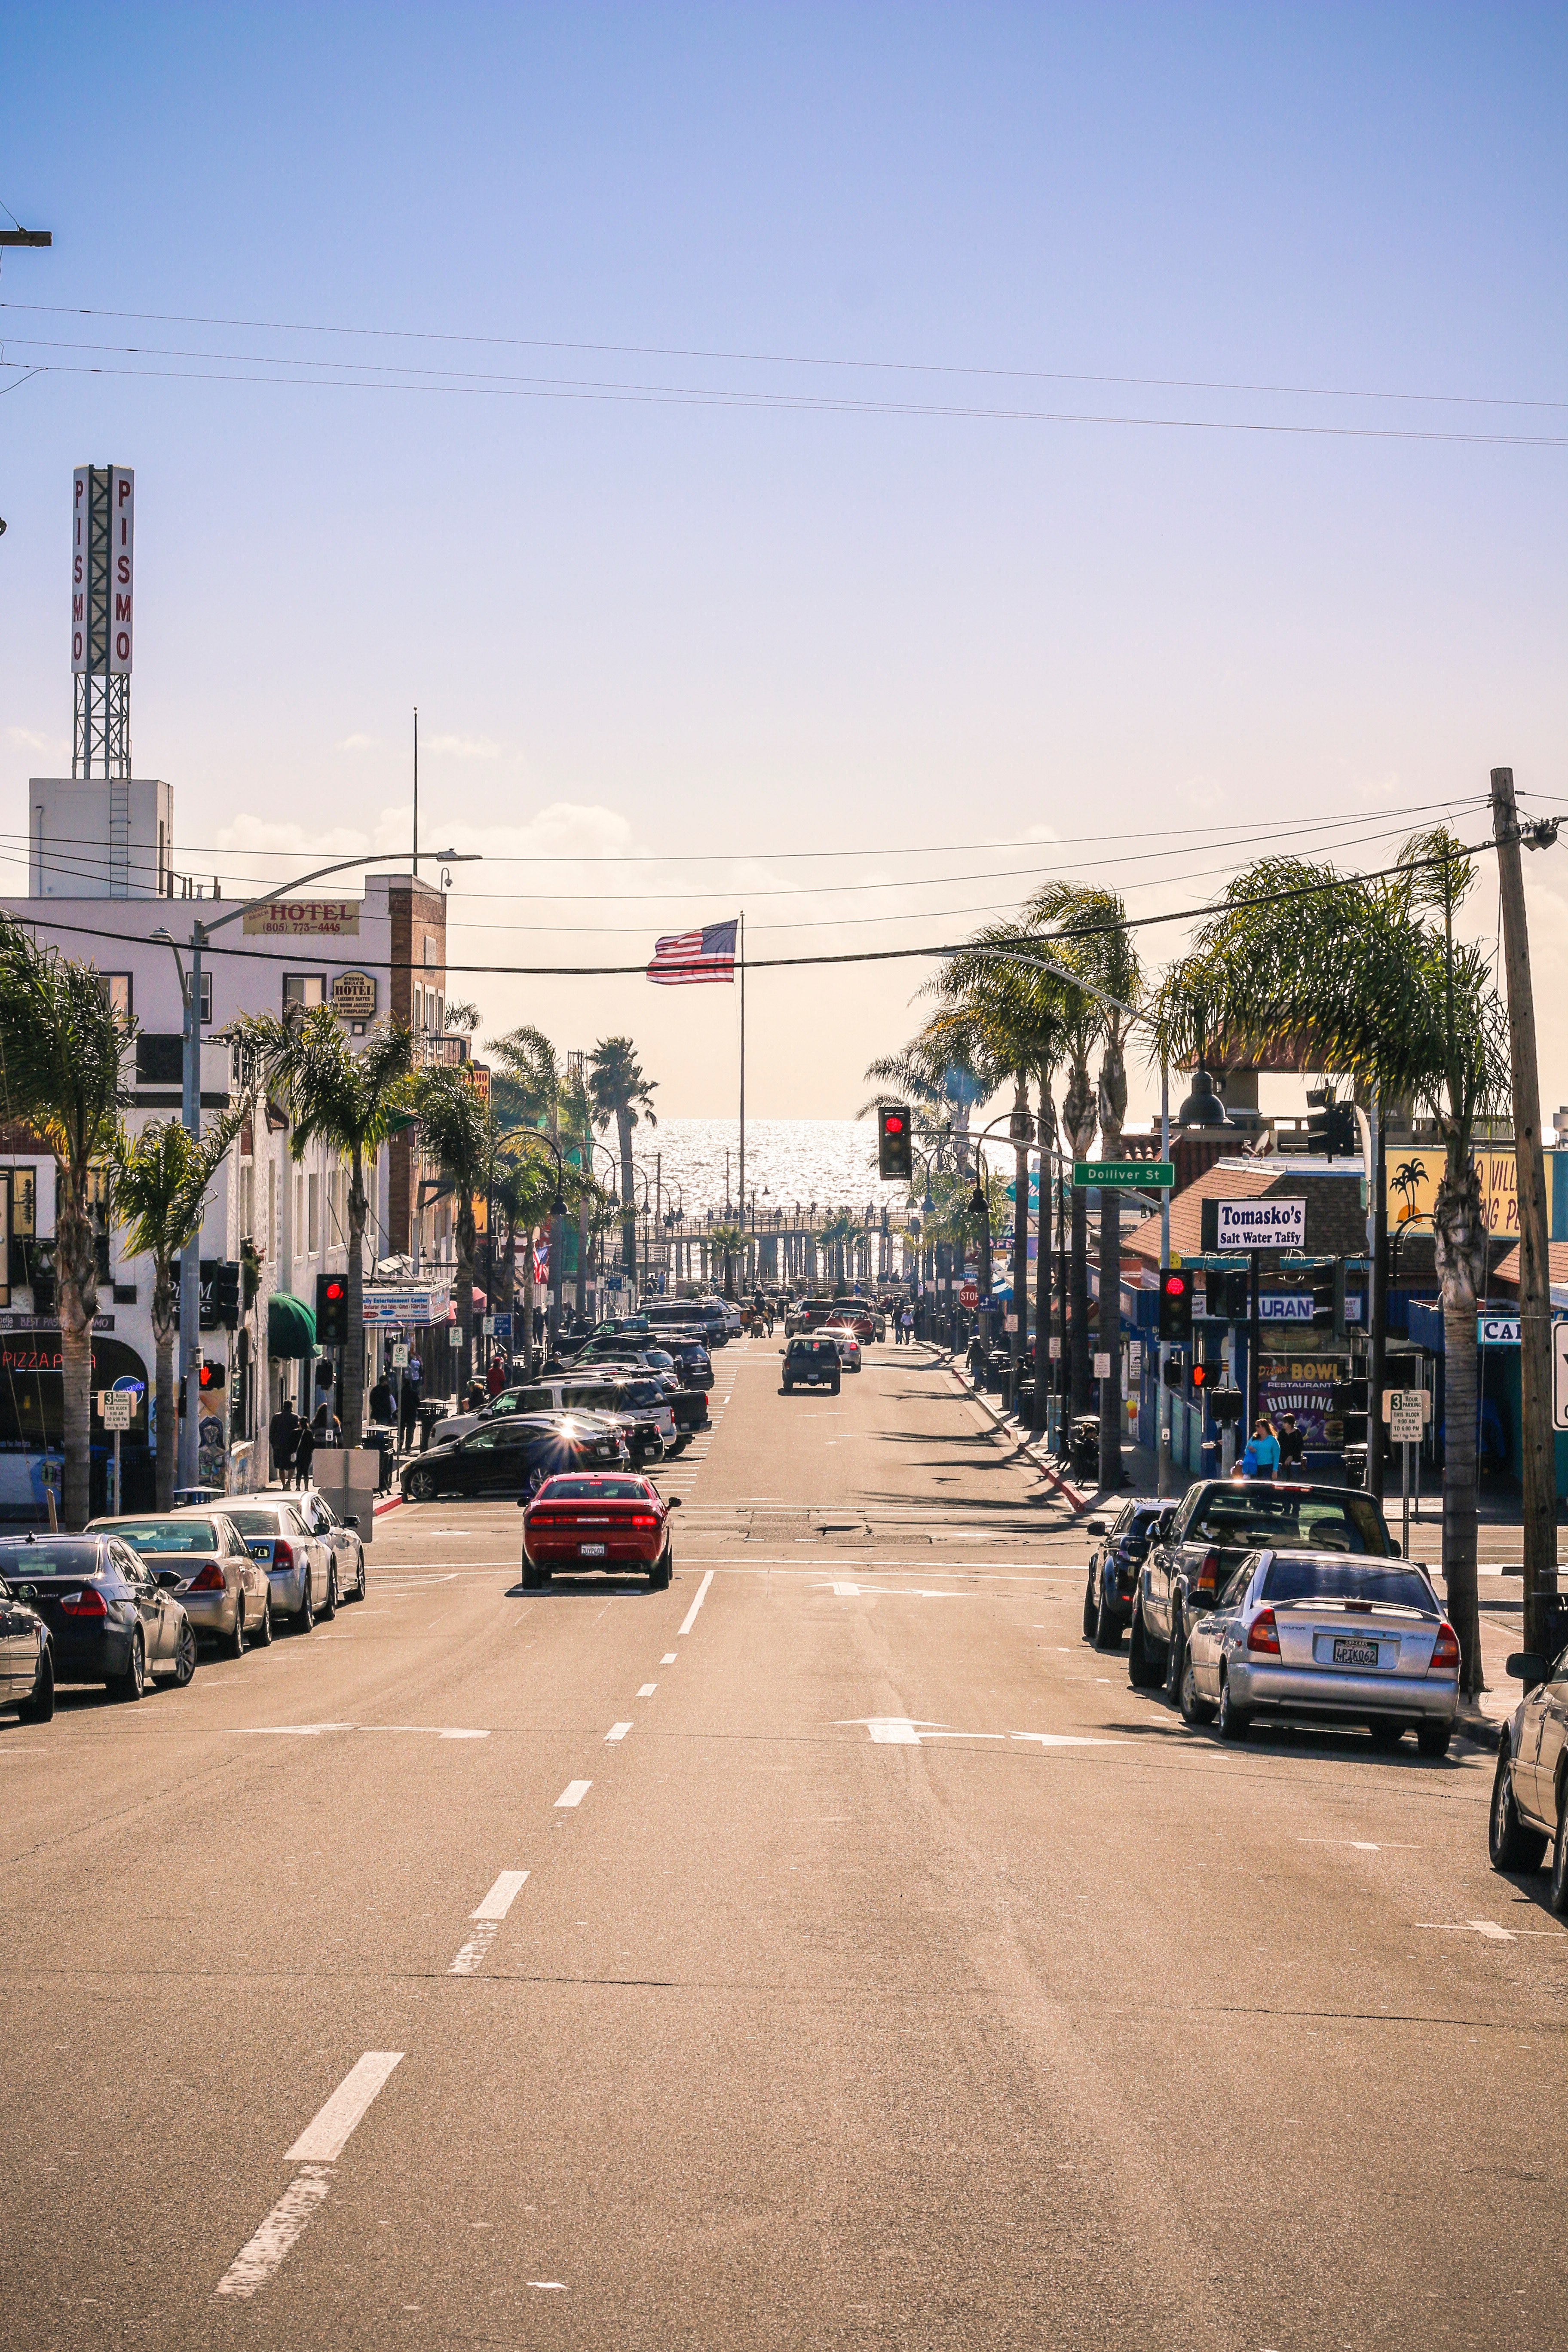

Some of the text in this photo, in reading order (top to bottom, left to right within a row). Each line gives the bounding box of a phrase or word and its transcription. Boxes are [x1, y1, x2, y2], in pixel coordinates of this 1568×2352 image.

[73, 480, 83, 660] PISMO
[116, 480, 131, 660] PISMO
[248, 911, 269, 921] BEACH
[270, 904, 354, 921] HOTEL
[263, 922, 340, 932] (805) 773-4445
[335, 986, 374, 995] HOTEL
[1088, 1169, 1160, 1179] Dolliver St
[1492, 1161, 1518, 1191] VILL
[1222, 1205, 1301, 1225] Tomasko's
[1220, 1231, 1301, 1245] Salt Water Taffy
[20, 1317, 40, 1327] BEST
[3, 1352, 49, 1367] PIZZA
[1292, 1363, 1342, 1380] BOWL
[106, 1393, 112, 1404] 3
[1266, 1395, 1333, 1412] BOWLING
[1393, 1395, 1400, 1409] 3
